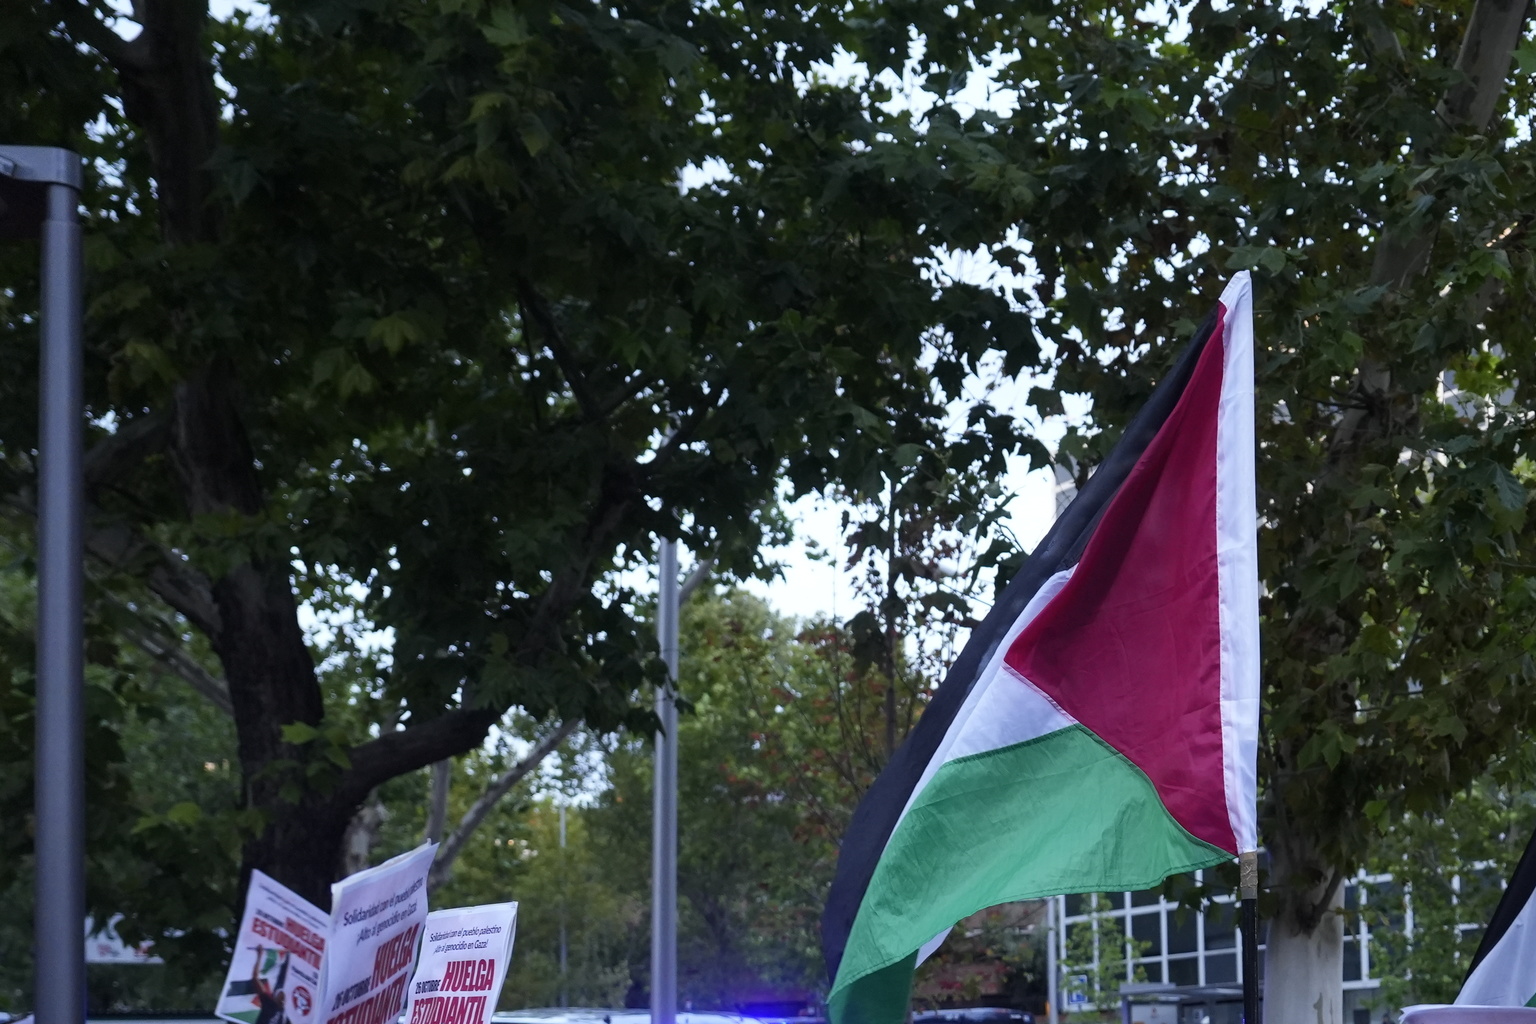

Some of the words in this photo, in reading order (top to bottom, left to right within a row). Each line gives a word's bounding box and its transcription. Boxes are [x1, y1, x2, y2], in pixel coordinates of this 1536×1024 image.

[479, 924, 502, 937] palestino
[370, 922, 420, 991] HUELGA
[421, 980, 441, 993] OCTUBRE
[440, 959, 495, 992] HUELGA
